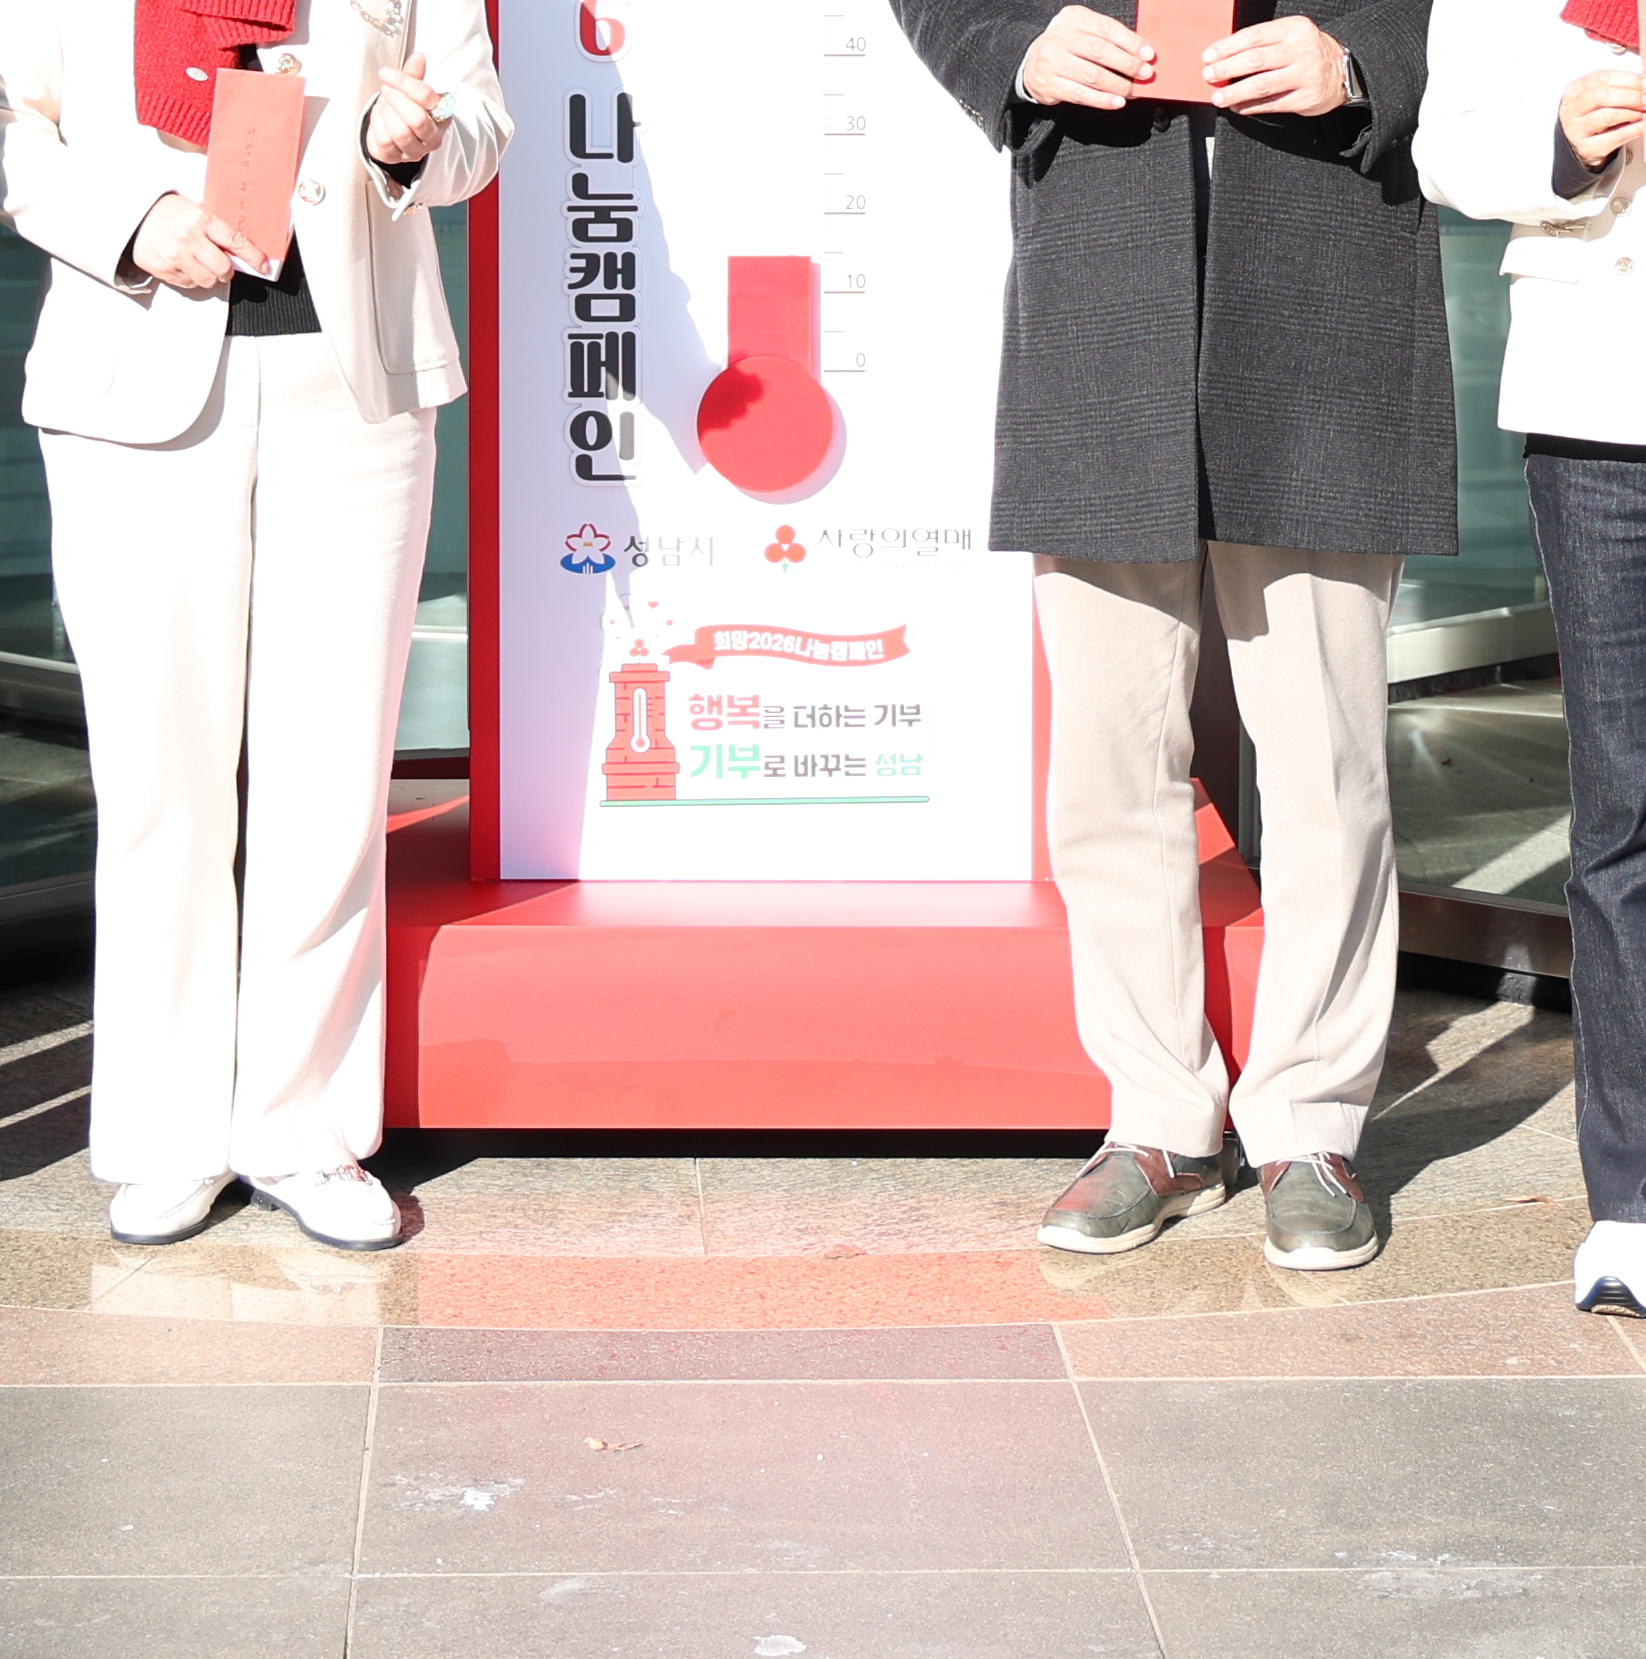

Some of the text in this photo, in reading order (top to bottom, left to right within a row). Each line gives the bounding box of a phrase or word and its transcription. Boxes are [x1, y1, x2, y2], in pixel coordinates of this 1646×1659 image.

[845, 37, 867, 52] 40
[846, 116, 867, 132] 30
[846, 195, 867, 210] 20
[565, 92, 642, 482] 나눔캠페인
[847, 273, 867, 289] 10
[855, 353, 866, 368] 0
[624, 535, 715, 568] 성남시
[816, 527, 972, 559] 사랑의열매
[712, 630, 884, 661] 희망2026나눔캠페인
[688, 694, 922, 730] 행복을 더하는 기부
[689, 743, 923, 779] 기부로 바꾸는 성남
